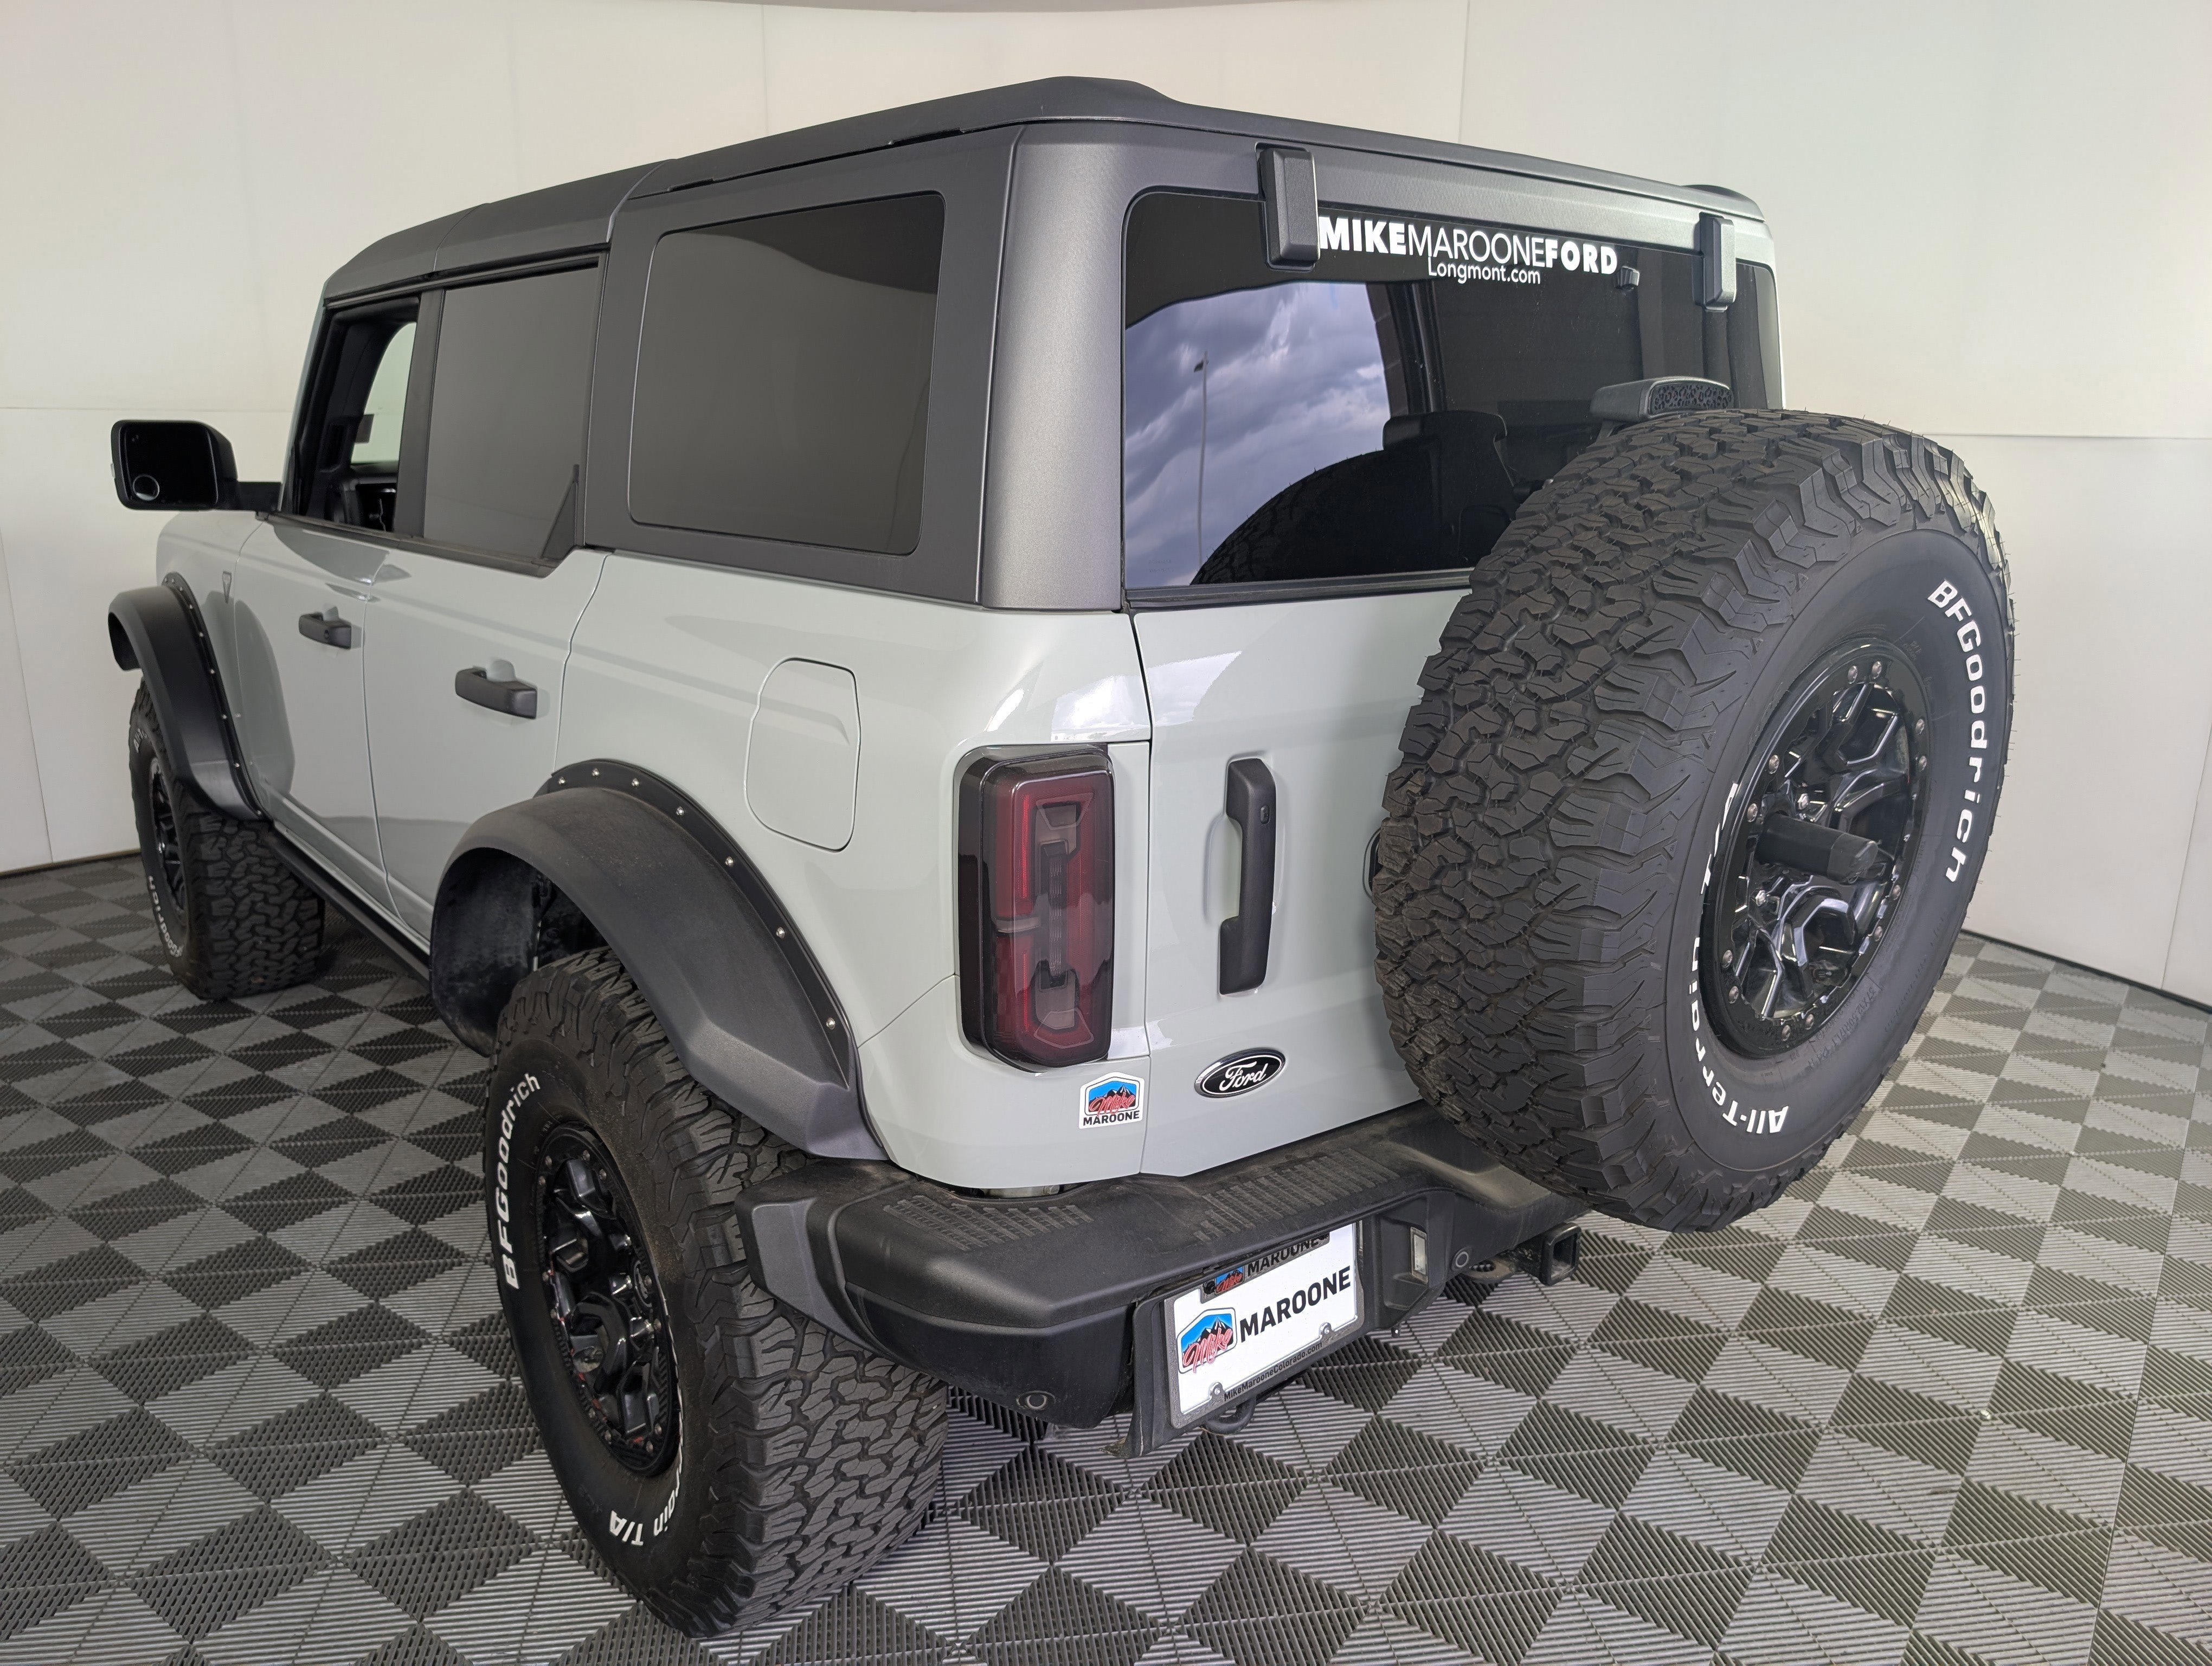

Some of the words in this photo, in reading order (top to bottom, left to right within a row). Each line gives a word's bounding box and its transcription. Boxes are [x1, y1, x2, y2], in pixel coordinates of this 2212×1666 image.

[1427, 255, 1541, 285] Longmont.com
[1927, 579, 1988, 883] BFGoodrich
[1219, 1061, 1268, 1092] Ford
[1083, 1109, 1140, 1126] MAROONE
[1088, 1091, 1136, 1117] Mike
[493, 1072, 541, 1290] BFGoodrich
[1216, 1272, 1243, 1292] Mike
[1182, 1327, 1233, 1374] Mike
[1239, 1265, 1352, 1342] MAROONE
[1224, 1341, 1323, 1402] MikeMarooneColorado.com
[609, 1509, 644, 1546] T/A
